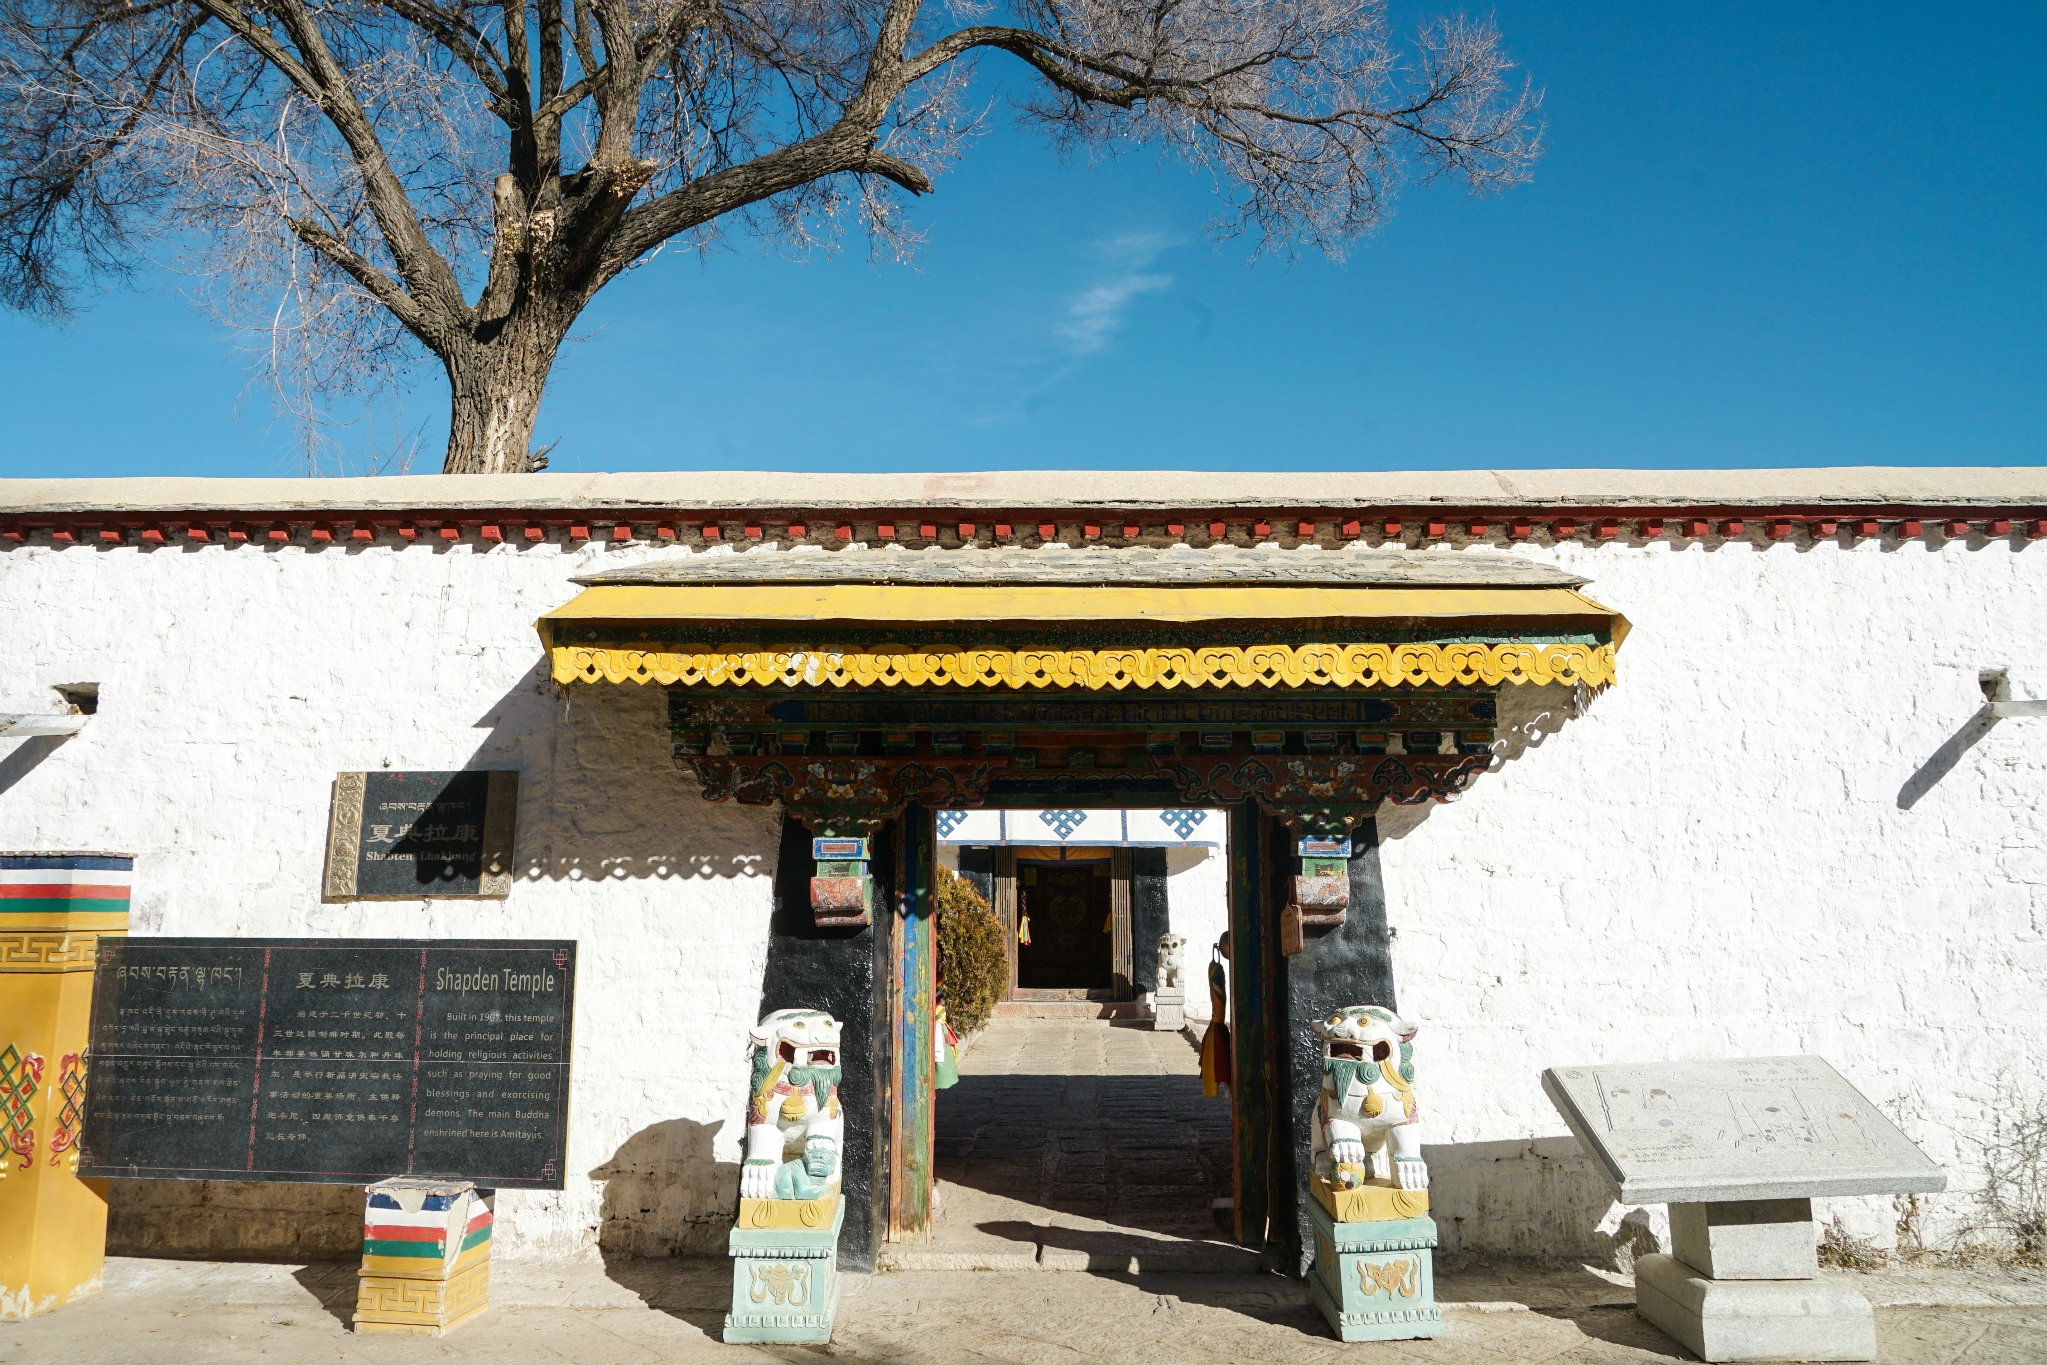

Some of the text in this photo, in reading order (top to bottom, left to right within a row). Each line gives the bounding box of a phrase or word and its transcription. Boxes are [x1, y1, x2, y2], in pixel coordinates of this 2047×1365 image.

[366, 824, 479, 842] 夏典拉康
[366, 851, 475, 861] Shabten Lhakhang
[296, 972, 390, 989] 夏典拉康
[436, 967, 554, 998] Shapden Temple
[447, 1012, 467, 1021] Built
[469, 1012, 477, 1021] in
[505, 1014, 521, 1022] this
[524, 1014, 554, 1024] temple
[430, 1032, 553, 1042] is the principal place for
[429, 1050, 553, 1061] holding religious activities
[428, 1069, 447, 1078] such
[469, 1071, 502, 1081] praying
[509, 1070, 522, 1079] for
[528, 1071, 551, 1082] good
[426, 1089, 550, 1101] blessings and exorcising
[425, 1108, 549, 1119] demons. The main Buddha
[424, 1128, 468, 1137] enshrined
[492, 1130, 498, 1138] is
[500, 1130, 544, 1141] Amitayus.
